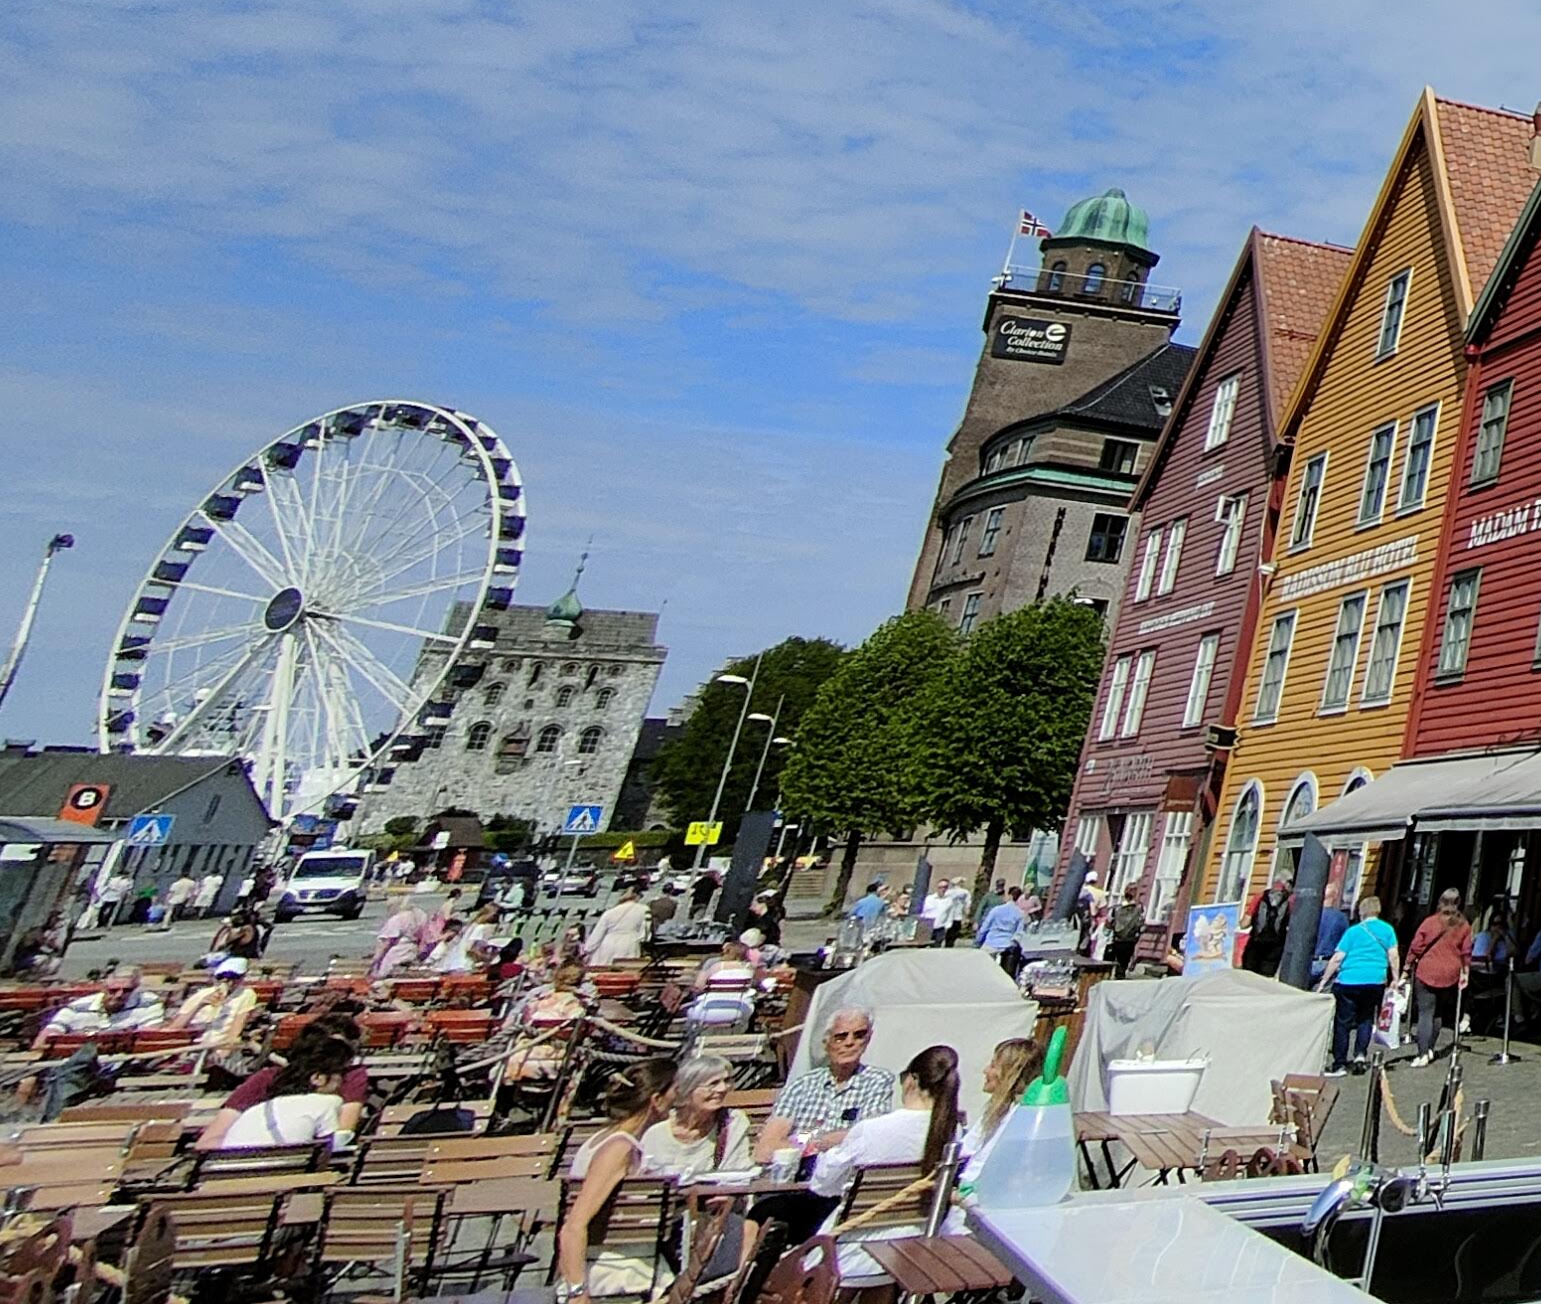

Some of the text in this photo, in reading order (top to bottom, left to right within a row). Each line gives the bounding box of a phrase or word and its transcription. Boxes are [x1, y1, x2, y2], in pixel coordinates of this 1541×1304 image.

[1000, 320, 1045, 338] Clarion
[1007, 336, 1063, 350] Collection
[1467, 504, 1531, 549] MADAM
[77, 791, 96, 807] B
